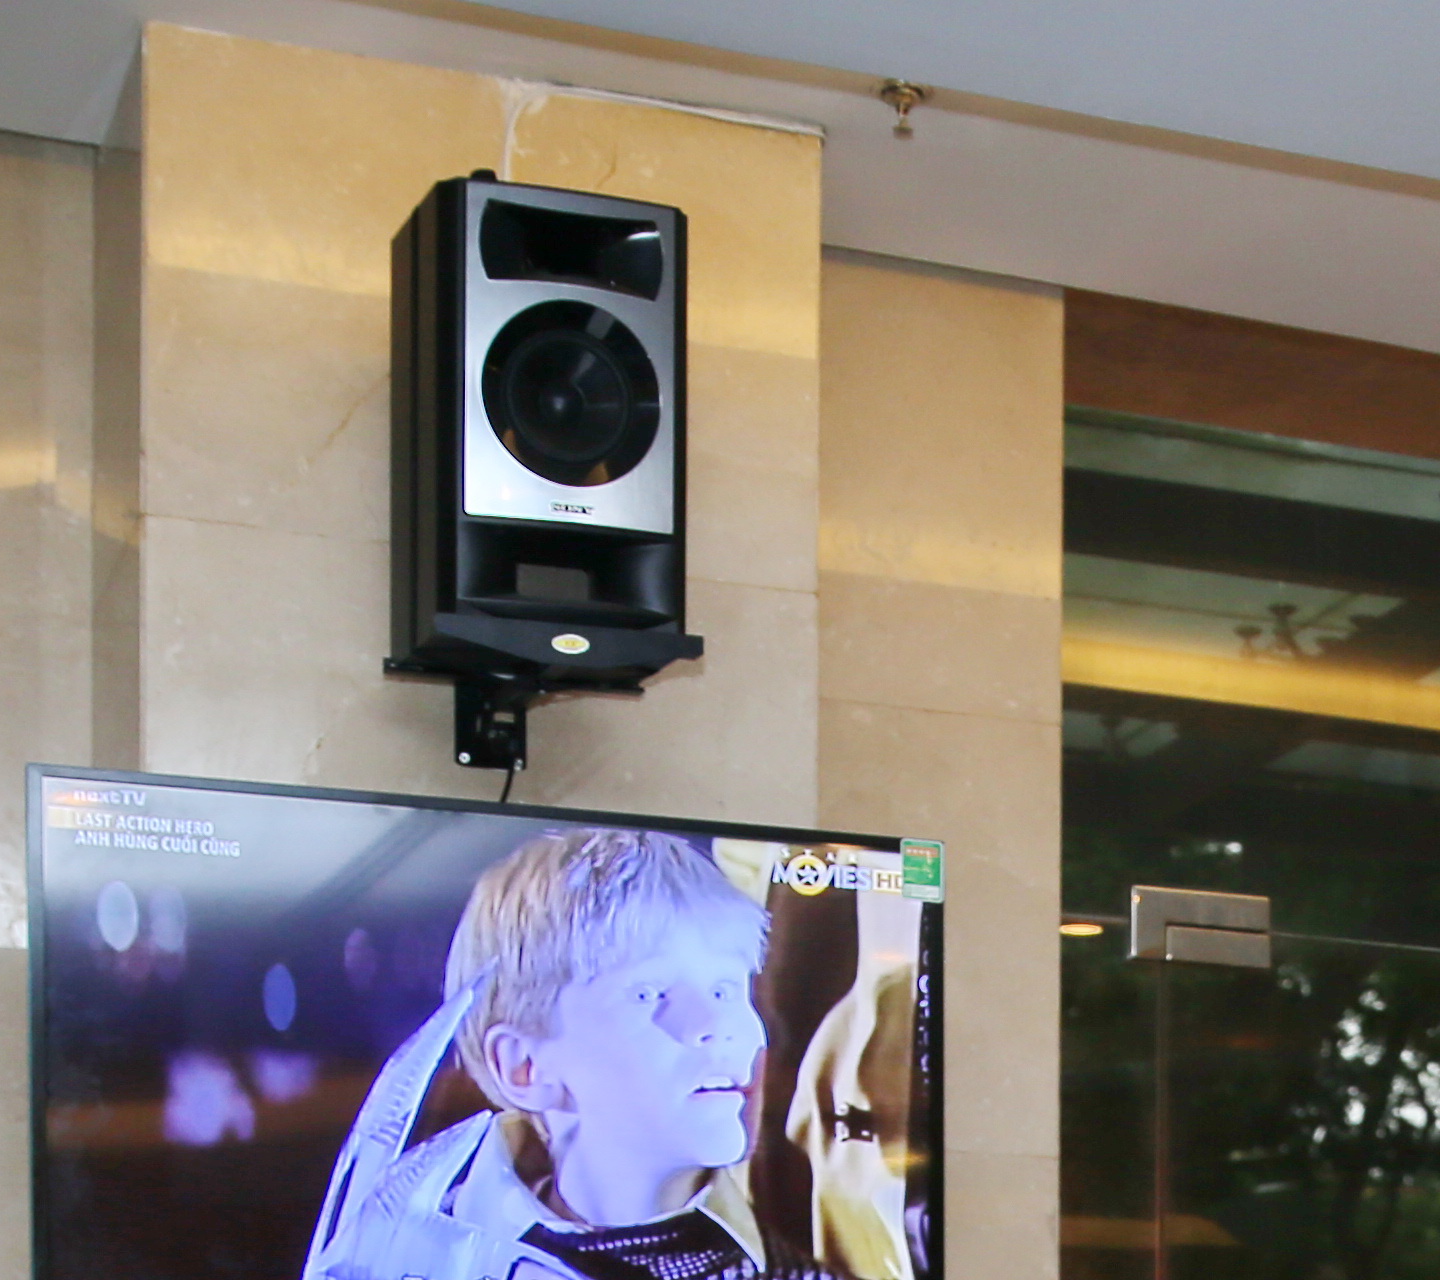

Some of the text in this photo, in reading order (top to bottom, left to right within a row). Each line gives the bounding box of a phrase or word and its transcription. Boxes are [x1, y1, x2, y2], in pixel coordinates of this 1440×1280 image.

[75, 812, 215, 838] LAST ACTION HERO
[74, 830, 111, 847] ANH
[114, 831, 159, 851] HÙNG
